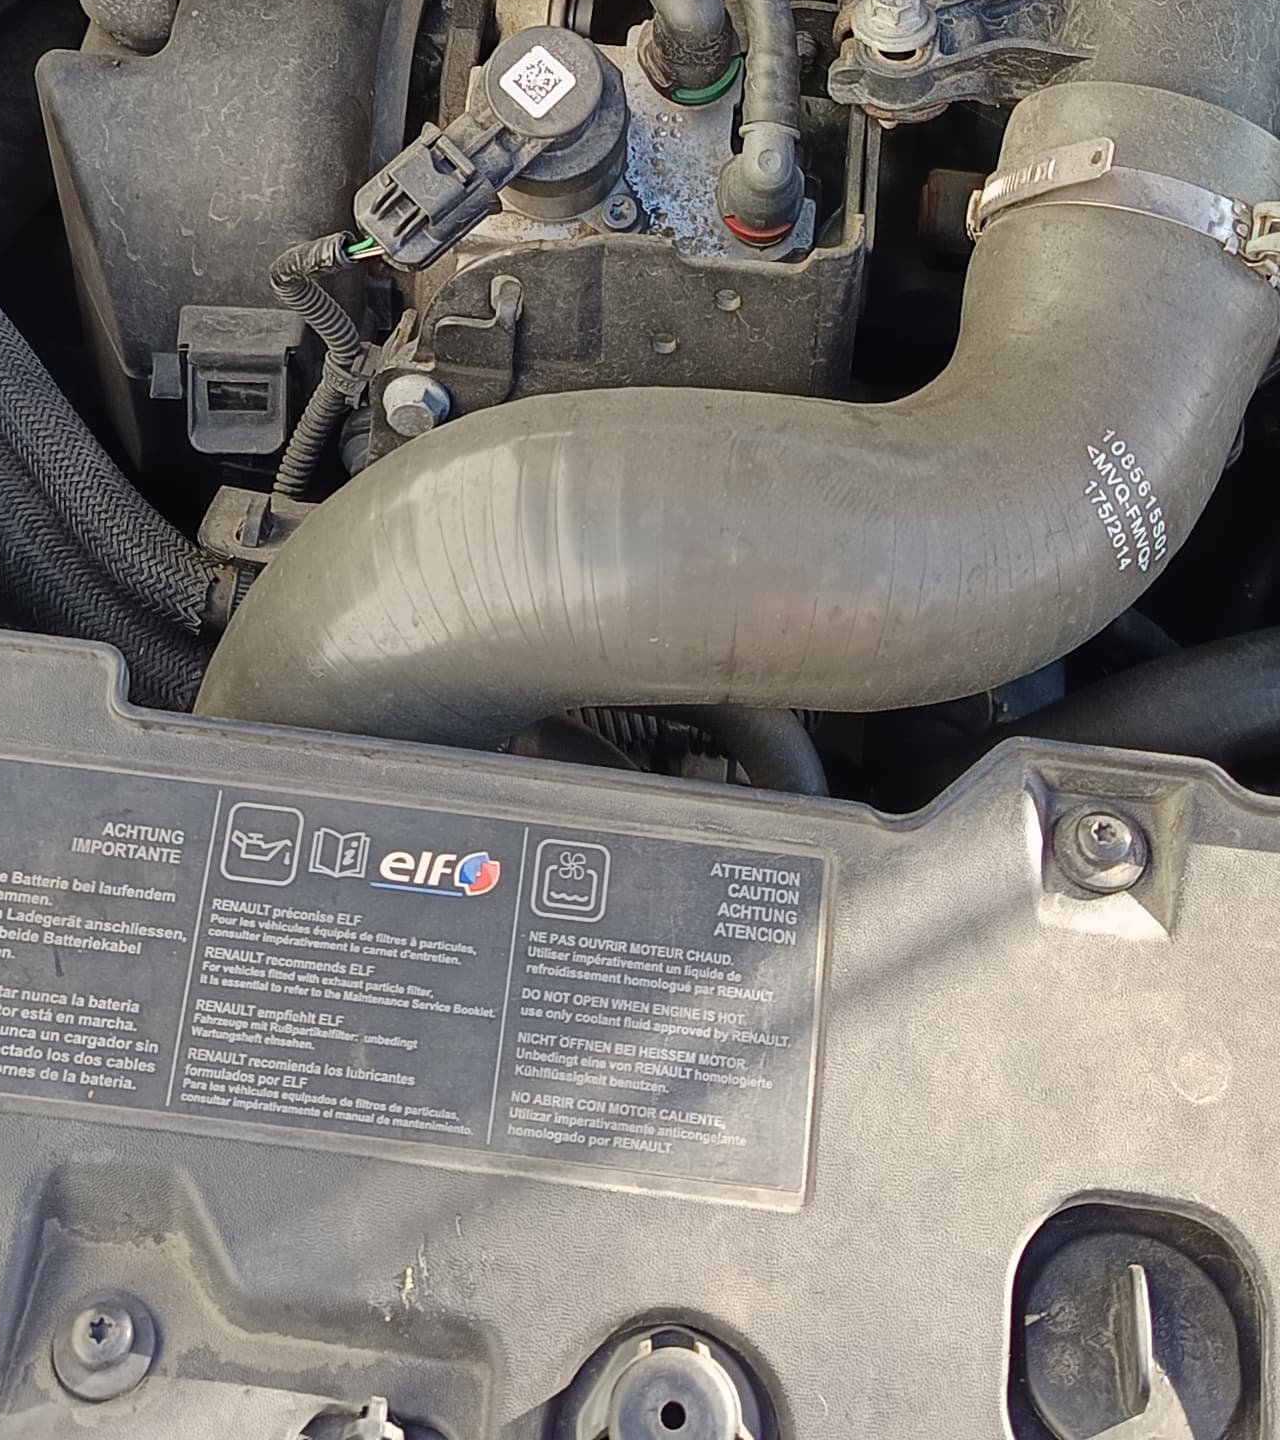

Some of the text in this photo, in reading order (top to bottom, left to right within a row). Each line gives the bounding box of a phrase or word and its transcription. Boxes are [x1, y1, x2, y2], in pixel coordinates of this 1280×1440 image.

[1102, 428, 1167, 561] 1085615S01
[1084, 479, 1133, 571] 175/2014
[70, 836, 183, 865] IMPORTANTE
[100, 821, 186, 846] ACHTUNG
[378, 850, 458, 887] elf
[709, 861, 802, 888] ATTENTION
[10, 870, 70, 891] Batterie
[71, 877, 98, 894] bei
[97, 880, 177, 904] laufendem
[726, 882, 801, 906] CAUTION
[5, 906, 84, 930] Ladegerät
[83, 918, 188, 944] anschliessen,
[210, 897, 364, 927] RENAULT préconise ELF
[716, 901, 798, 926] ACHTUNG
[527, 929, 549, 945] NE
[548, 932, 577, 948] PAS
[577, 935, 629, 954] OUVRIR
[628, 941, 685, 961] MOTEUR
[712, 921, 797, 946] ATENCION
[203, 944, 377, 978] RENAULT recommends ELF
[526, 944, 743, 983] Utiliser impérativement un liquide de
[200, 959, 435, 1000] For vehicles fitted with exhaust particle filter,
[525, 962, 623, 985] refroidissement
[622, 972, 692, 995] homologué
[693, 984, 716, 997] par
[194, 997, 346, 1028] RENAULT empfiehlt ELF
[520, 986, 543, 1002] DO
[542, 989, 573, 1005] NOT
[571, 992, 610, 1010] OPEN
[610, 997, 651, 1015] WHEN
[651, 1002, 701, 1021] ENGINE
[702, 1009, 717, 1023] IS
[519, 1005, 545, 1019] use
[544, 1007, 574, 1025] only
[573, 1012, 622, 1028] coolant
[622, 1015, 652, 1032] fluid
[651, 1022, 713, 1039] approved
[712, 1026, 731, 1044] by
